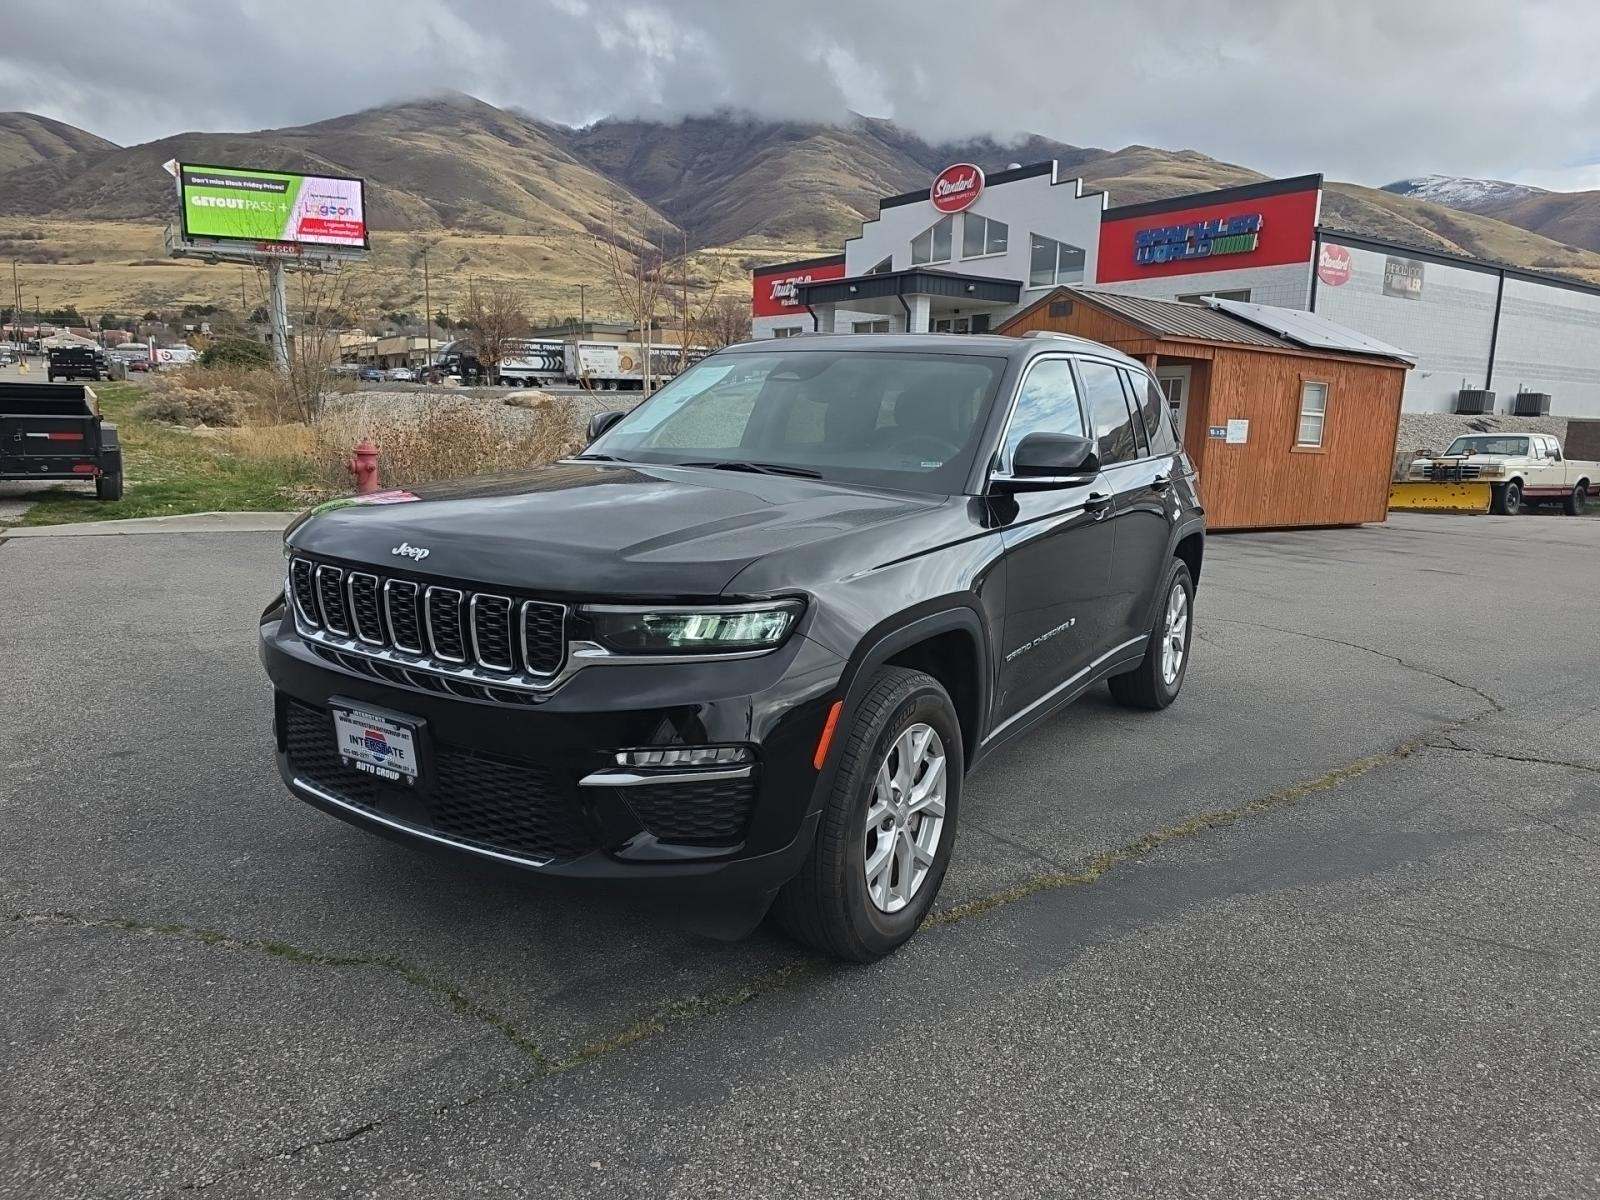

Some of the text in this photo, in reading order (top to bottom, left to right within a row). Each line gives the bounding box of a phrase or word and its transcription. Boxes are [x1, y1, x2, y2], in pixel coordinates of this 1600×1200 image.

[225, 179, 243, 187] Black
[243, 181, 263, 190] Friday
[934, 169, 976, 198] Standard
[1319, 251, 1351, 271] Standard
[391, 542, 430, 562] Jeep
[349, 734, 405, 760] INTERSTATE
[356, 761, 400, 781] AUTO GROUP
